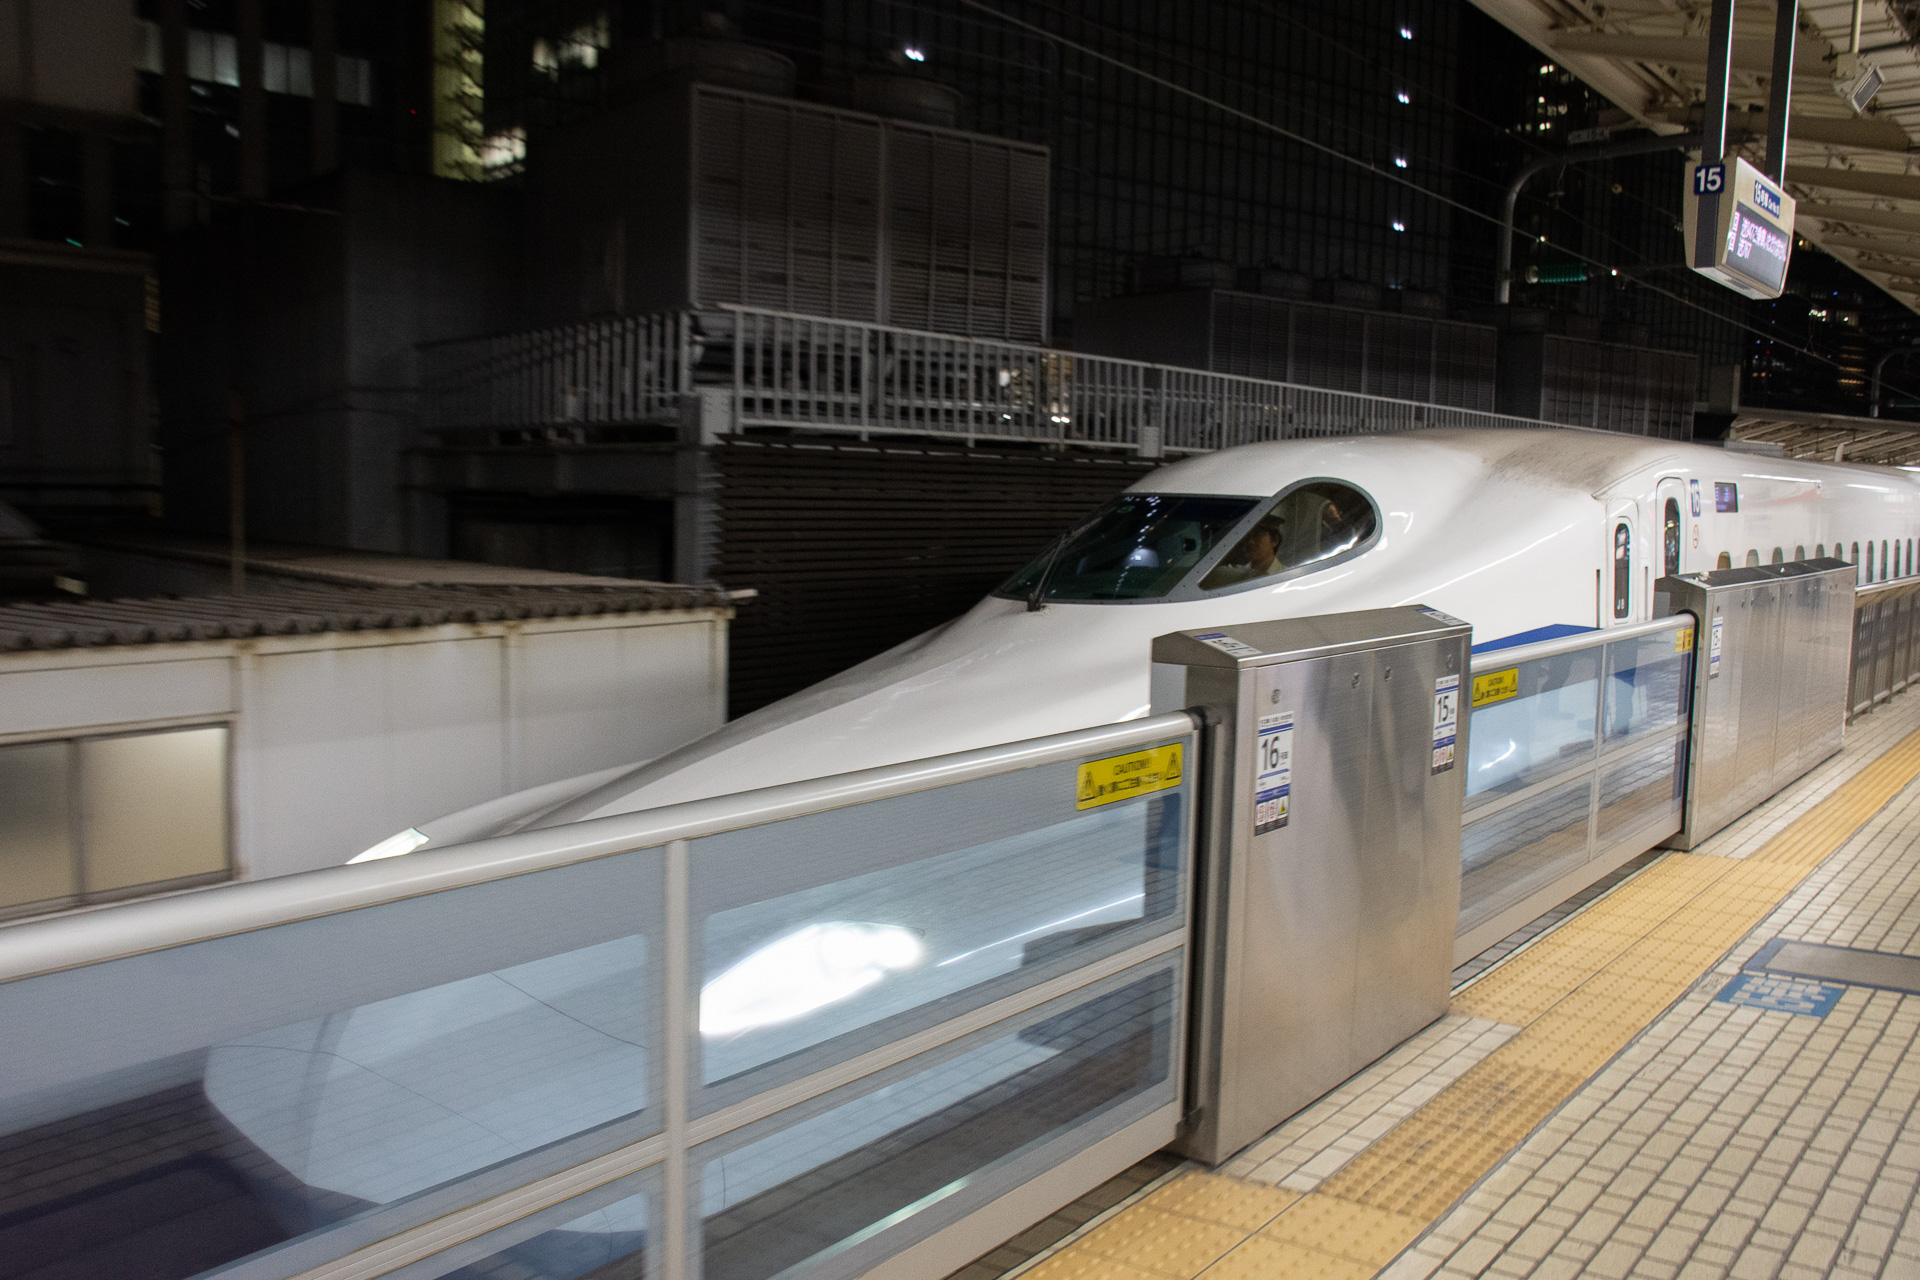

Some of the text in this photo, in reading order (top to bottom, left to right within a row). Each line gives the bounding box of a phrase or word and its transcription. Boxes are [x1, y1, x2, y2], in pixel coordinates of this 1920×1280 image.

[1696, 167, 1721, 192] 15
[1437, 695, 1449, 723] 15
[1262, 736, 1279, 770] 16
